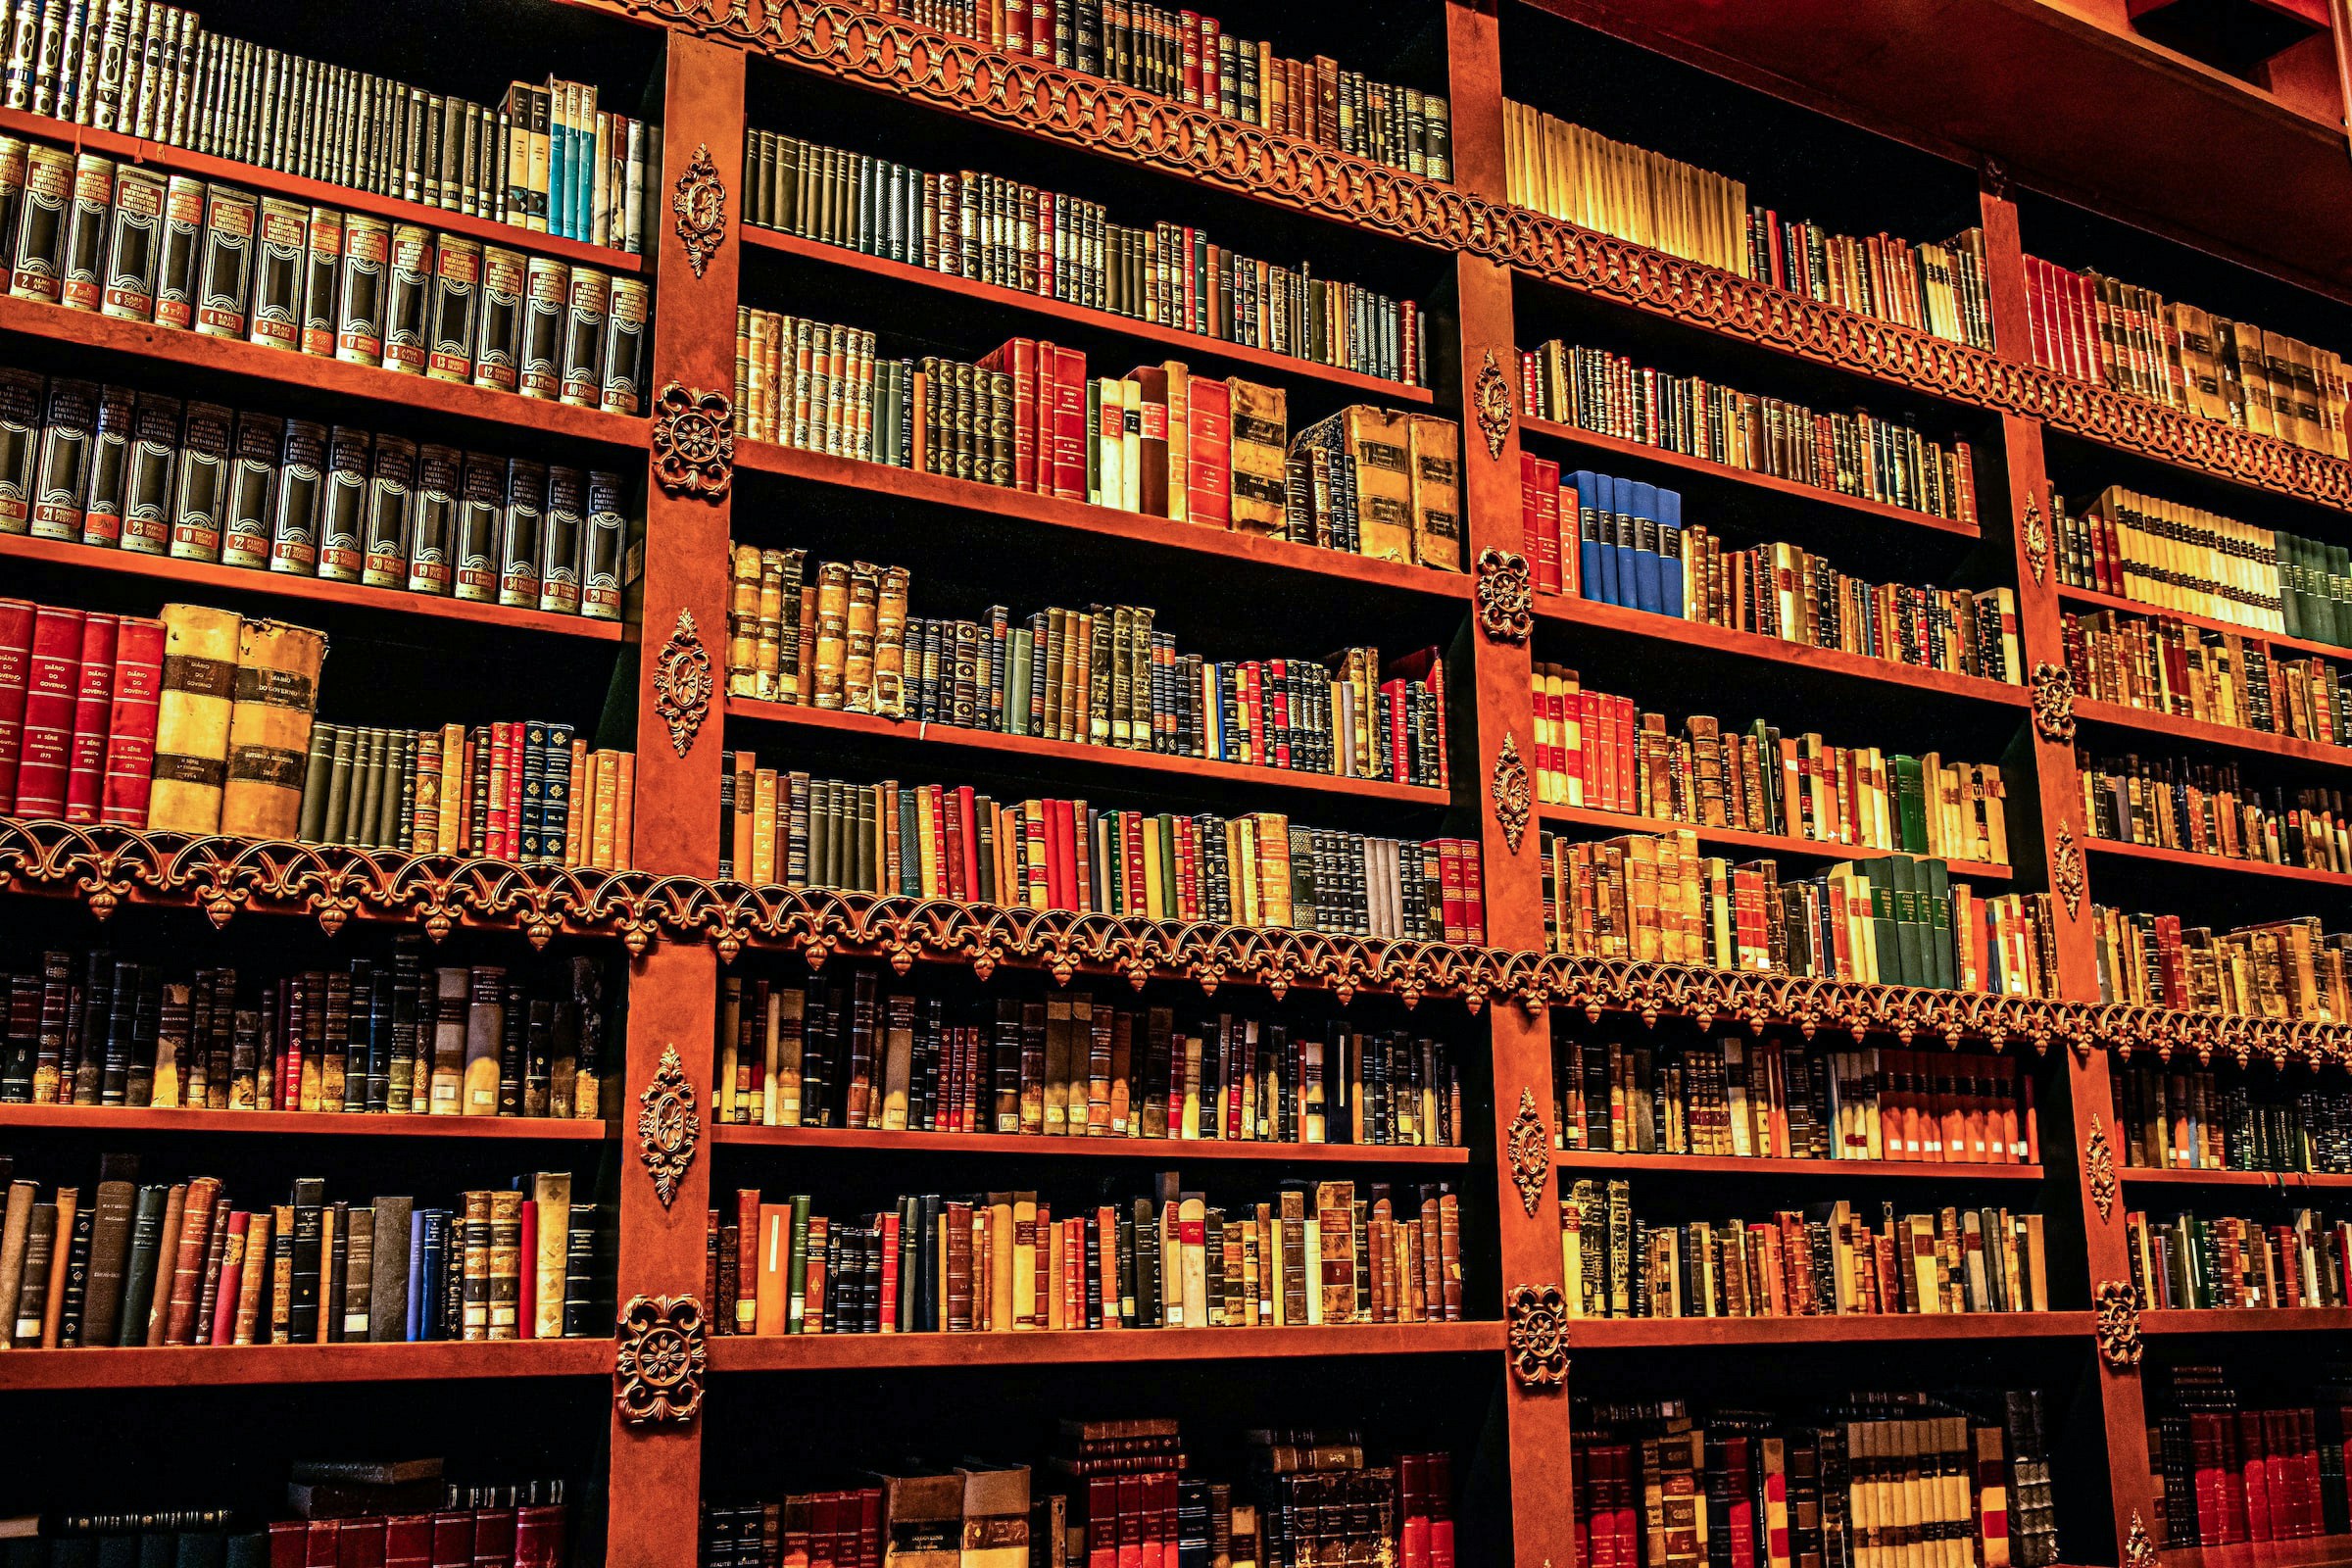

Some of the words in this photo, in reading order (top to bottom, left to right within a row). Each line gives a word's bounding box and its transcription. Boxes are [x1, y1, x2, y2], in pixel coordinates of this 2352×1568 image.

[129, 183, 151, 195] GRANDE
[122, 195, 157, 208] PORTUGUESA
[122, 201, 156, 214] BRASILEIRA
[274, 214, 295, 225] GRANDE
[266, 233, 299, 245] BRASILEIRA
[267, 226, 301, 240] PORTUGUESA
[22, 275, 28, 288] 2
[69, 284, 77, 294] 7
[114, 293, 121, 304] 6
[160, 303, 169, 313] 6
[208, 312, 213, 324] 4
[262, 321, 268, 333] 5
[306, 331, 314, 343] 8
[347, 337, 356, 348] 17
[392, 347, 397, 358] 3
[436, 357, 445, 368] 13
[484, 366, 492, 378] 12
[527, 374, 537, 387] 39
[568, 383, 579, 395] 40
[608, 392, 617, 405] 38
[42, 507, 53, 520] 21
[132, 521, 143, 535] 23
[182, 529, 192, 541] 10
[234, 537, 244, 549] 22
[282, 545, 291, 557] 37
[329, 551, 339, 563] 36
[372, 557, 382, 569] 20
[419, 565, 428, 576] 19
[465, 572, 473, 583] 11
[508, 578, 517, 590] 34
[548, 584, 559, 596] 30
[590, 590, 600, 602] 29
[45, 664, 65, 672] DIÁRIO
[40, 681, 67, 689] GOVERNO
[268, 686, 297, 696] GOVERNO
[123, 688, 150, 696] GOVERNO
